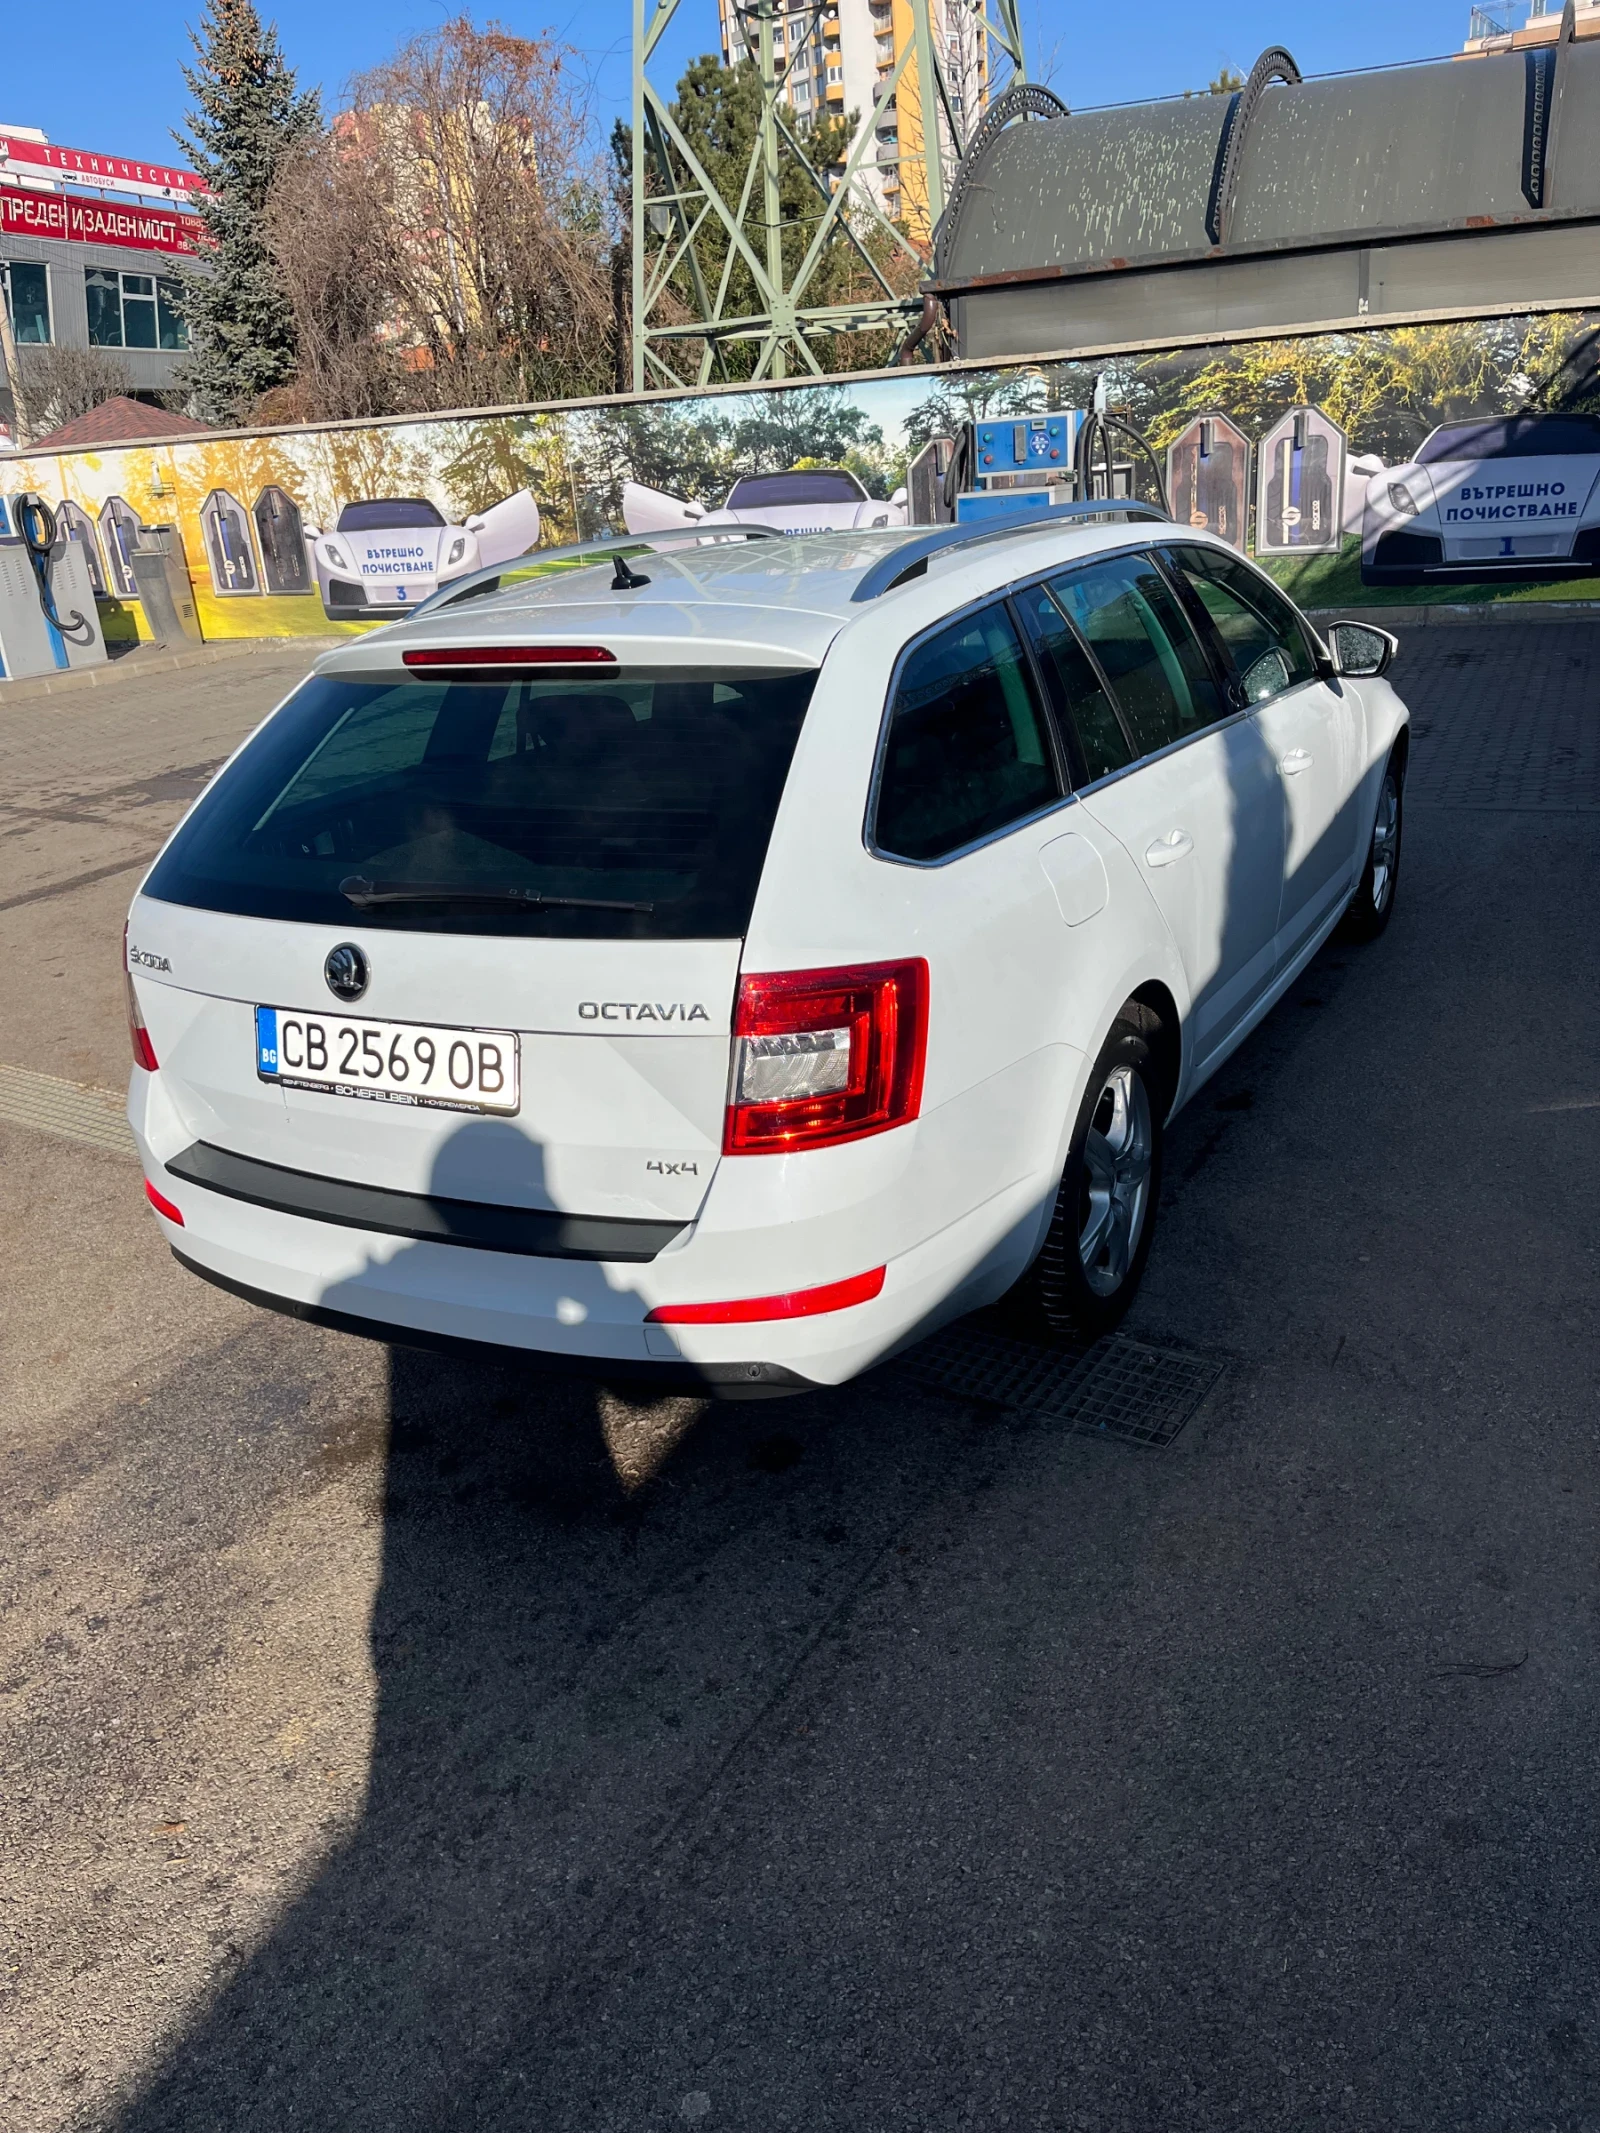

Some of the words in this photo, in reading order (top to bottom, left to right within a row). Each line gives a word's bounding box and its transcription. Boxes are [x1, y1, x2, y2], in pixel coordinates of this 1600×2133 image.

[44, 148, 185, 187] ТЕХНИЧЕСКИ
[81, 174, 115, 187] АВТОБУСИ
[85, 209, 136, 237] ЗАДЕН
[138, 217, 176, 243] МОСТ
[1460, 482, 1565, 500] ВЪТРЕШНО
[1446, 501, 1578, 521] ПОЧИСТВАНЕ
[366, 547, 424, 559] ВЪТРЕШНО
[1498, 536, 1515, 556] 1
[362, 561, 434, 574] ПОЧИСТВАНЕ
[396, 585, 407, 601] 3
[578, 1001, 711, 1021] OCTAVIA
[262, 1048, 277, 1064] BG
[282, 1019, 329, 1070] CB
[338, 1026, 436, 1085] 2569
[335, 1085, 418, 1105] SCHIEFELBEIN
[646, 1160, 699, 1176] 4x4
